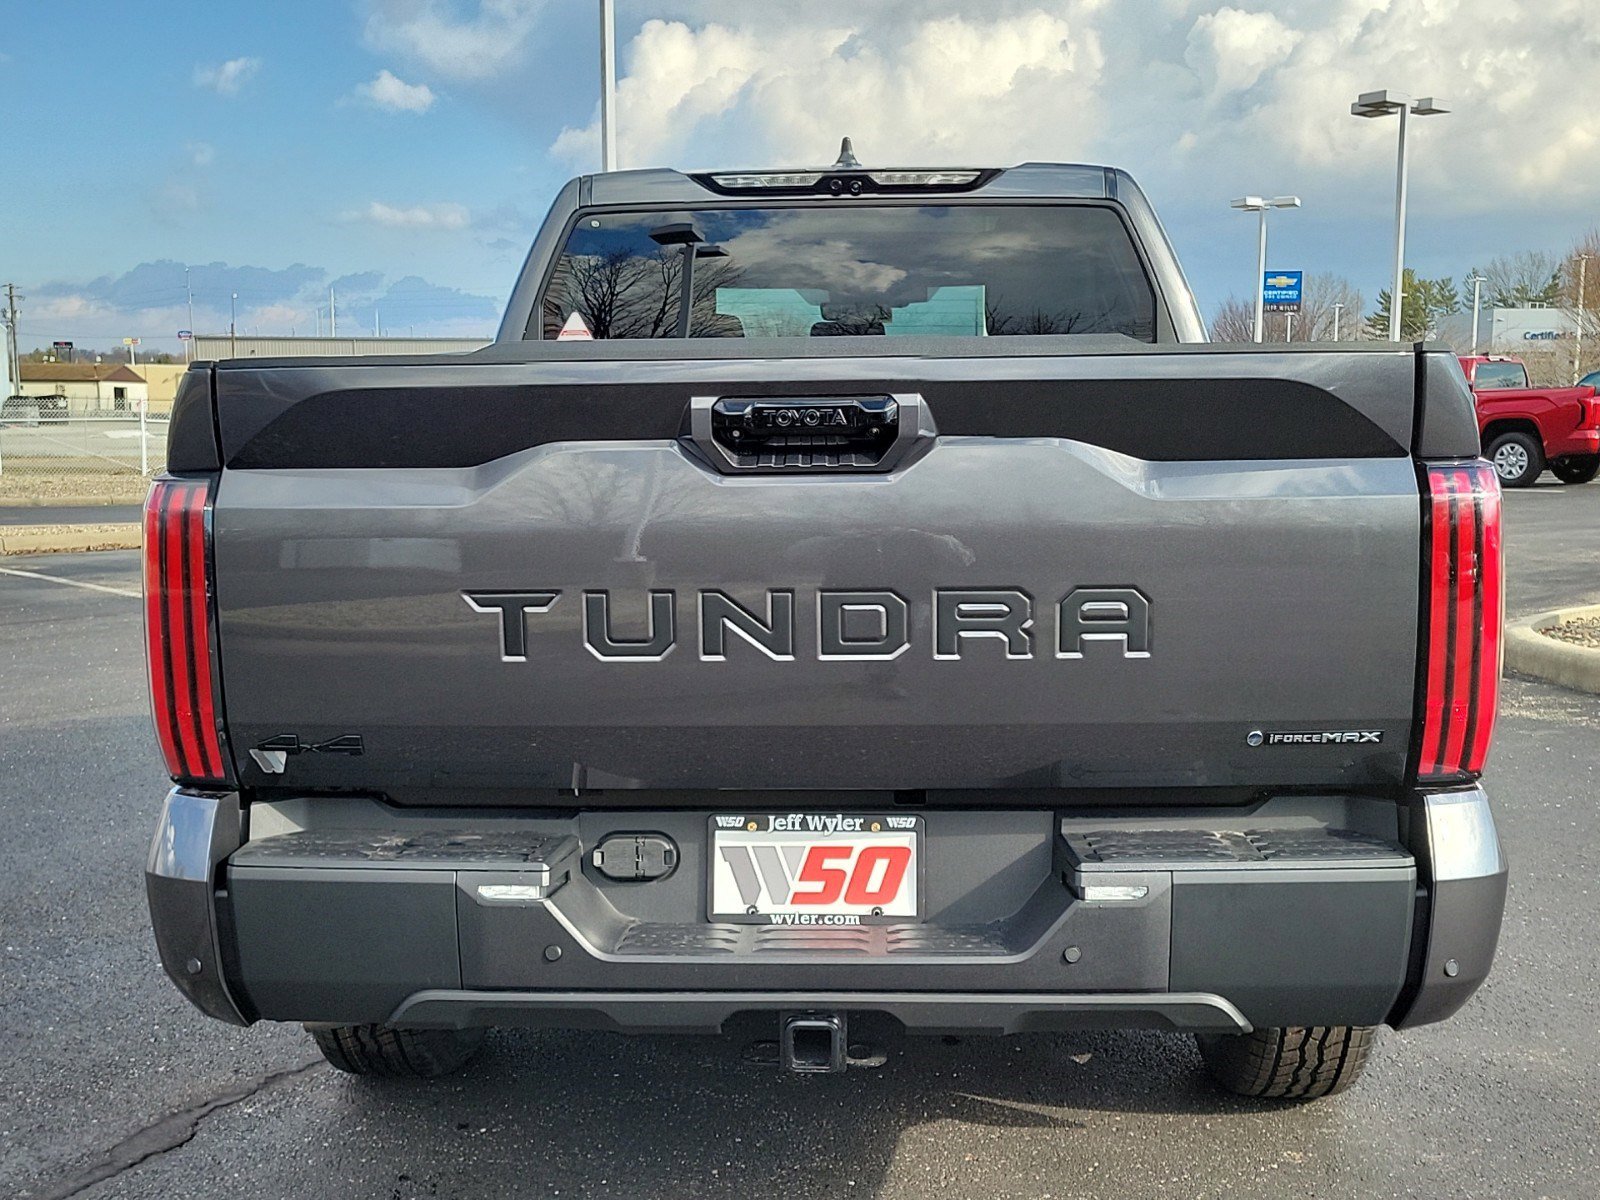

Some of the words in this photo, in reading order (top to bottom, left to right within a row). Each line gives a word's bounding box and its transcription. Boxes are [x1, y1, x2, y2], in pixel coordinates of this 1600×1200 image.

[762, 408, 847, 427] TOYOTA
[459, 585, 1152, 663] TUNDRA
[715, 816, 745, 828] W50
[767, 814, 804, 832] Jeff
[806, 815, 864, 836] Wyler
[886, 817, 917, 829] W50
[719, 845, 912, 905] W50
[770, 912, 861, 926] wyler.com
